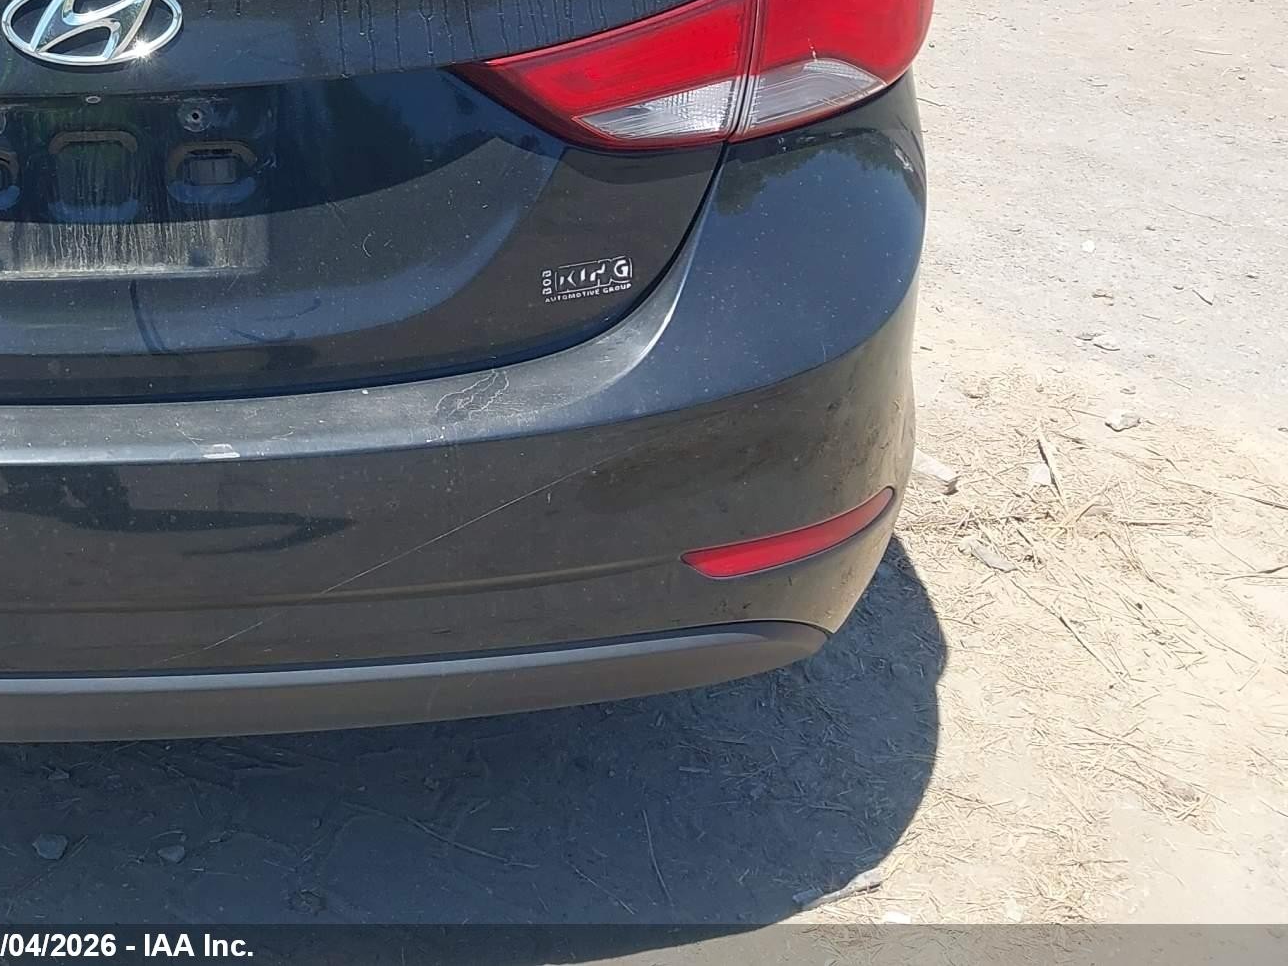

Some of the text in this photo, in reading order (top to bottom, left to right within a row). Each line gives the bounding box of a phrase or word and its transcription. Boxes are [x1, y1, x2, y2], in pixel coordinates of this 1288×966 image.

[541, 269, 553, 295] BOB
[544, 283, 632, 303] AUTOMOTIVE GROUP
